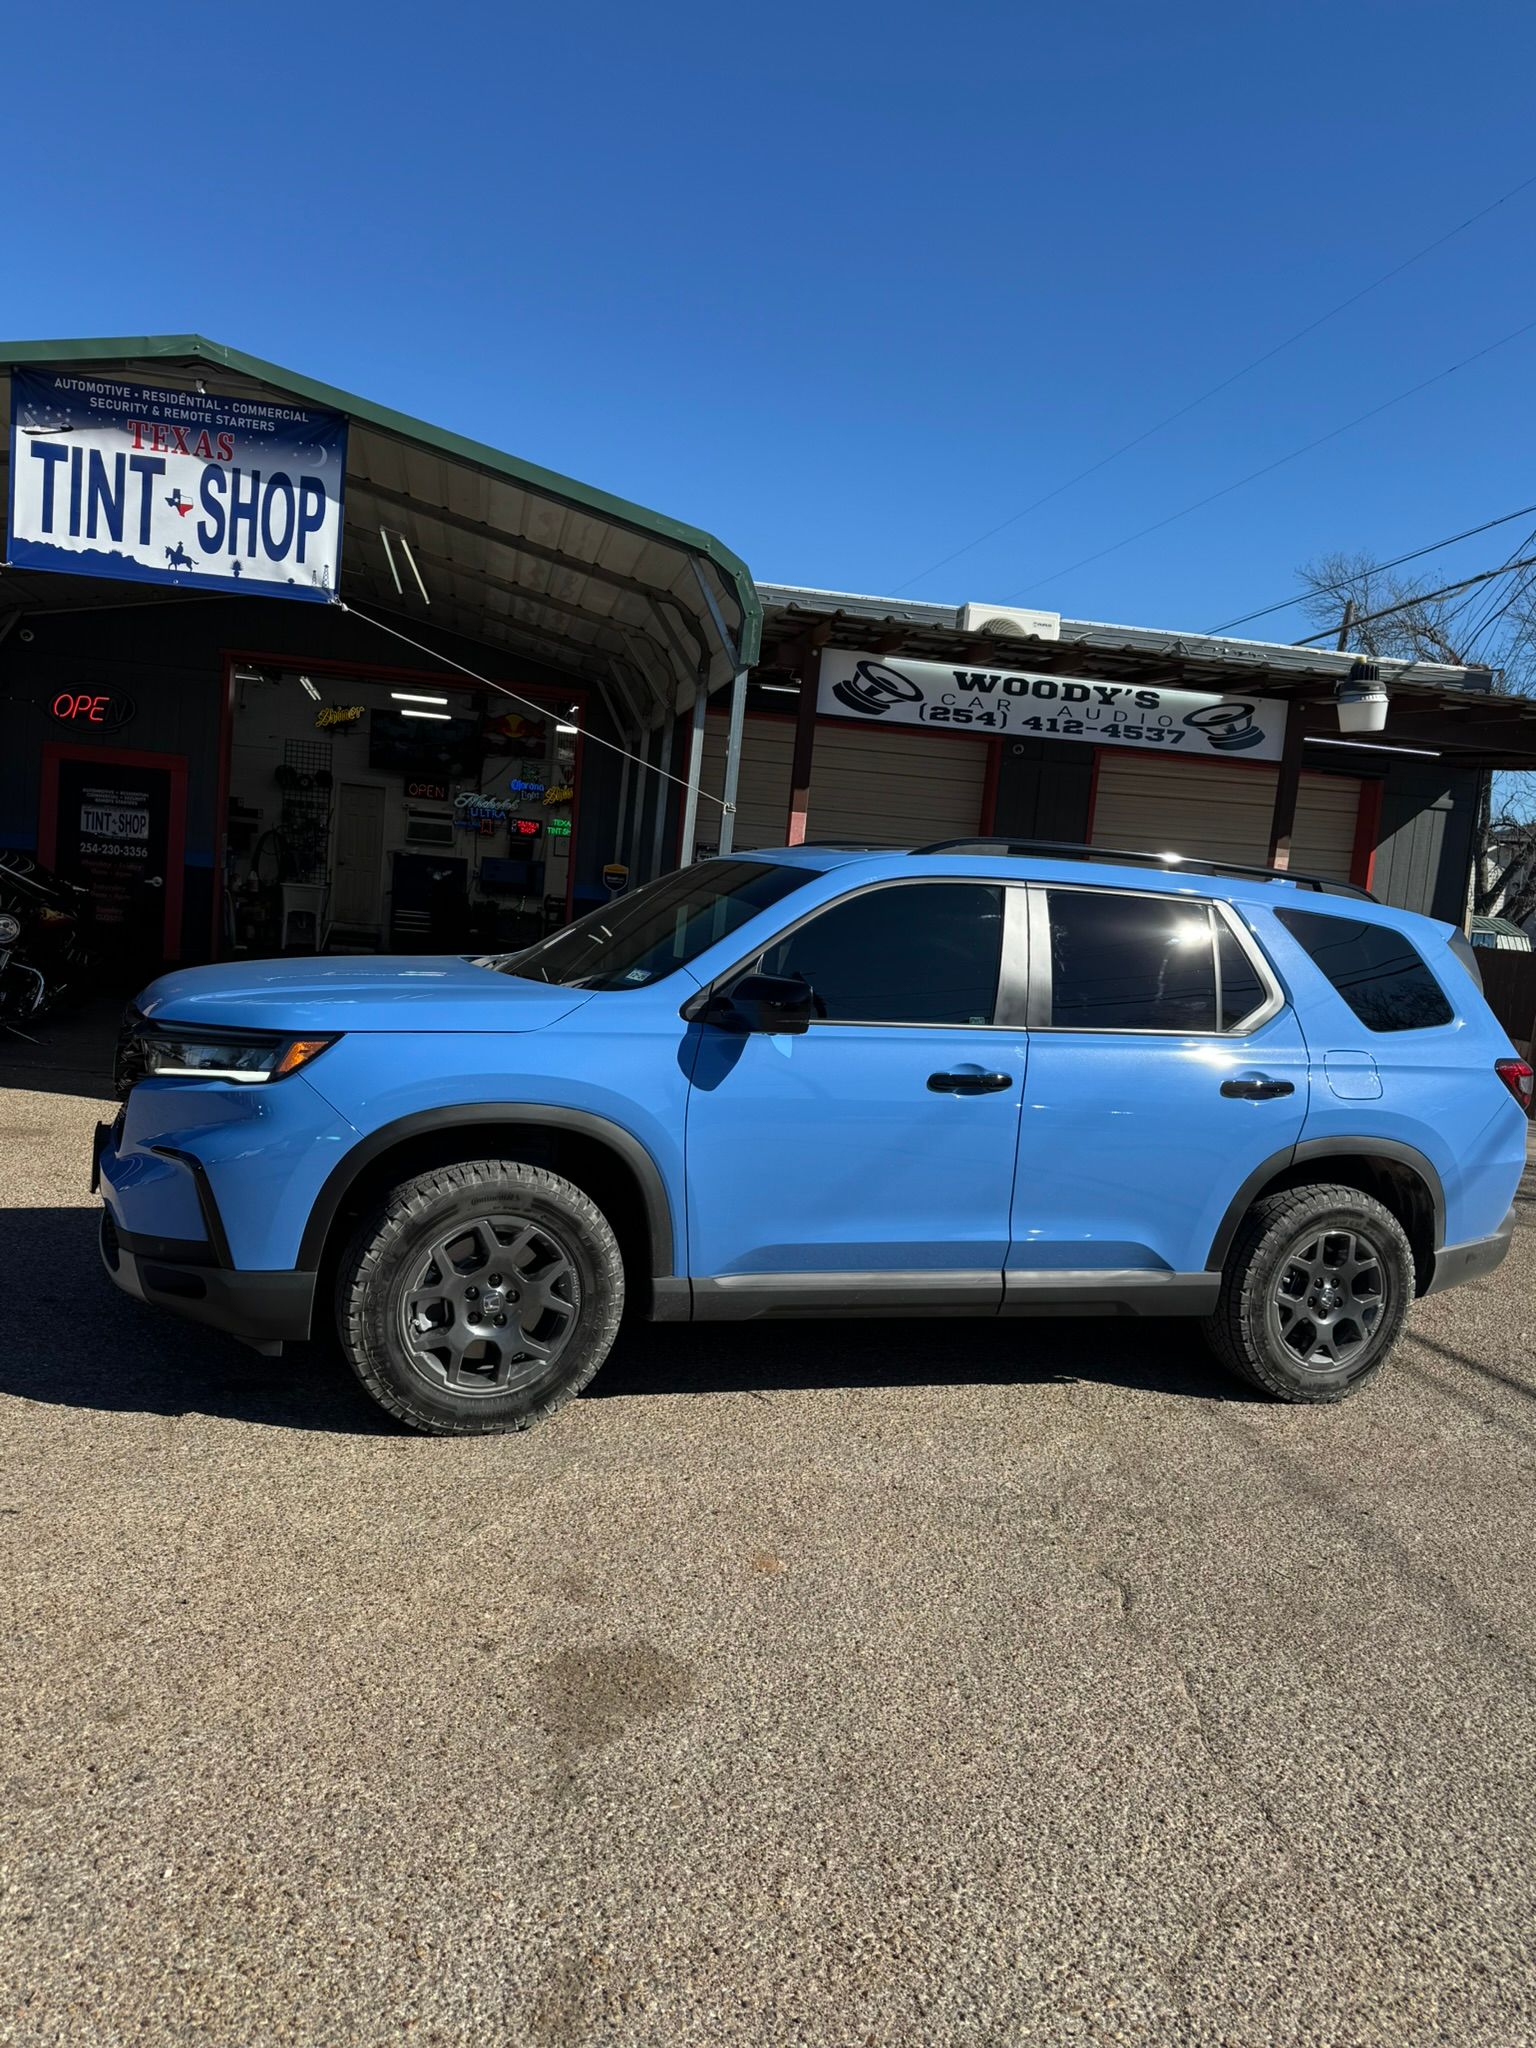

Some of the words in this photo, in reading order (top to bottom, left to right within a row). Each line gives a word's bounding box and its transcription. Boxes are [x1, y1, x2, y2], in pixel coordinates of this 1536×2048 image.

[54, 377, 131, 398] AUTOMOTIVE
[142, 390, 221, 411] RESIDENTIAL
[232, 402, 309, 423] COMMERCIAL
[89, 397, 149, 415] SECURITY
[151, 405, 160, 416] &
[164, 407, 212, 424] REMOTE
[215, 414, 275, 432] STARTERS
[127, 419, 235, 462] TEXAS
[30, 440, 166, 546] TINT
[197, 462, 326, 564] SHOP
[953, 671, 1160, 710] WOODY'S
[919, 702, 1007, 730] (254)
[1022, 716, 1186, 745] 412-4537
[941, 693, 1011, 712] CAR
[1057, 705, 1173, 728] AUDIO
[408, 783, 444, 798] OPEN
[84, 811, 112, 831] TINT
[119, 814, 146, 834] SHOP
[470, 807, 506, 819] ULTRA
[552, 818, 572, 827] TEXA
